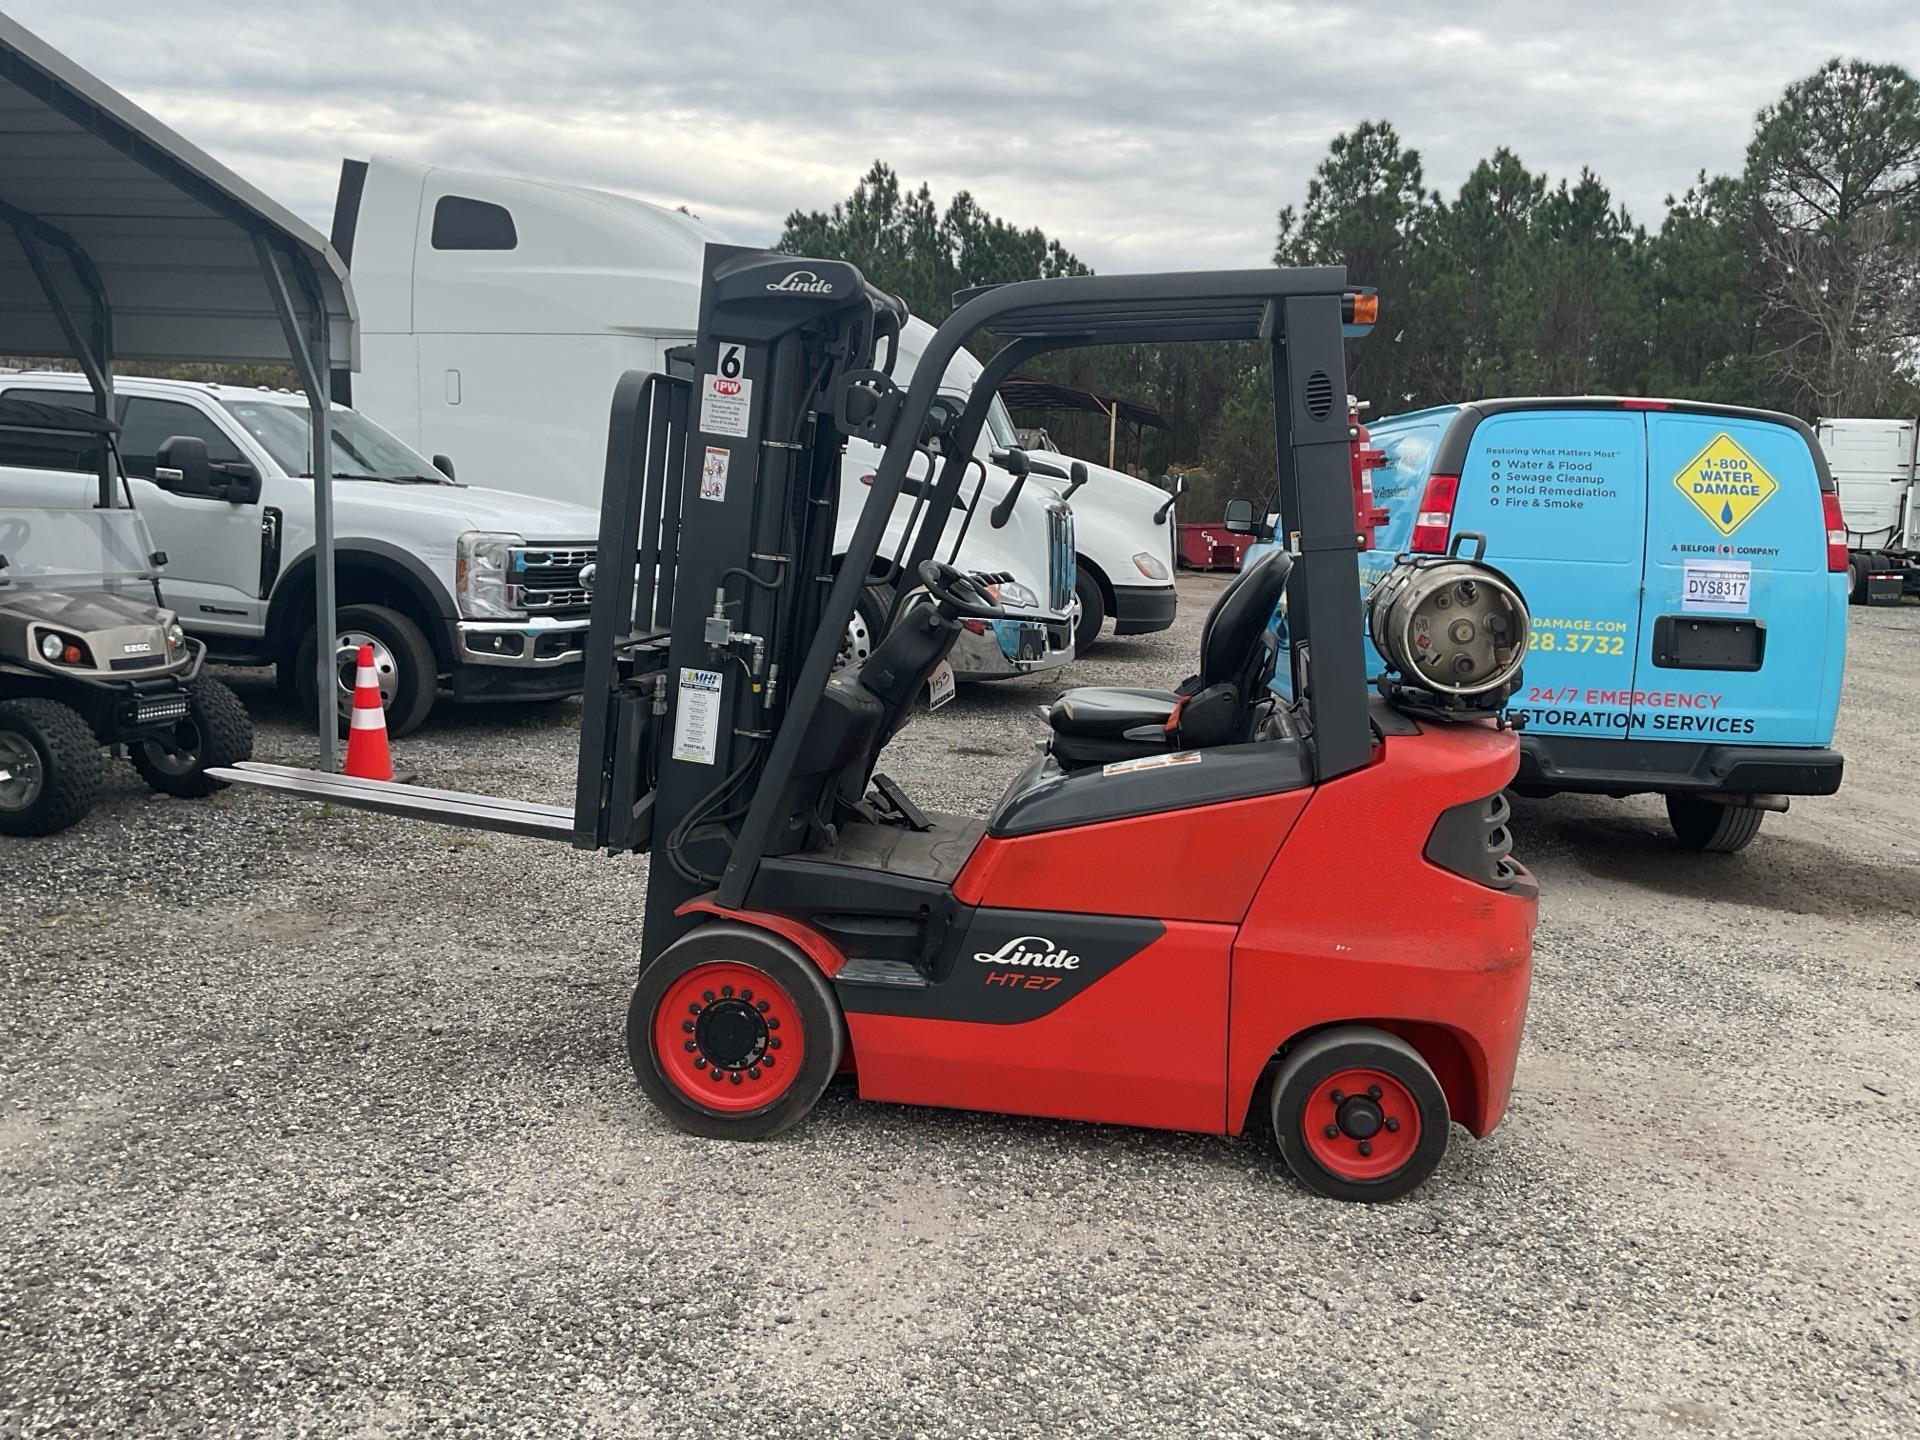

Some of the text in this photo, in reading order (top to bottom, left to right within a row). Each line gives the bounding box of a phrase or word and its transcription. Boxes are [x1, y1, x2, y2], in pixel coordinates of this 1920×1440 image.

[766, 271, 833, 294] Linde
[720, 346, 741, 379] 6
[715, 381, 739, 393] IPW
[1486, 447, 1529, 456] Restoring
[1531, 448, 1555, 456] What
[1558, 449, 1591, 457] Matters
[1507, 460, 1593, 471] Water & Flood
[1705, 458, 1749, 470] 1-800
[1506, 472, 1605, 485] Sewage Cleanup
[1699, 470, 1753, 483] WATER
[1506, 485, 1617, 498] Mold Remediation
[1693, 482, 1761, 497] DAMAGE
[1505, 498, 1584, 509] Fire & Smoke
[1671, 544, 1780, 556] A BELFOR COMPANY
[1689, 579, 1746, 596] DYS8317
[1530, 617, 1627, 633] DAMAGE.COM
[1528, 686, 1722, 710] 24/7 EMERGENCY
[1500, 708, 1755, 733] ESTORATION SERVICES
[973, 936, 1080, 970] Linde
